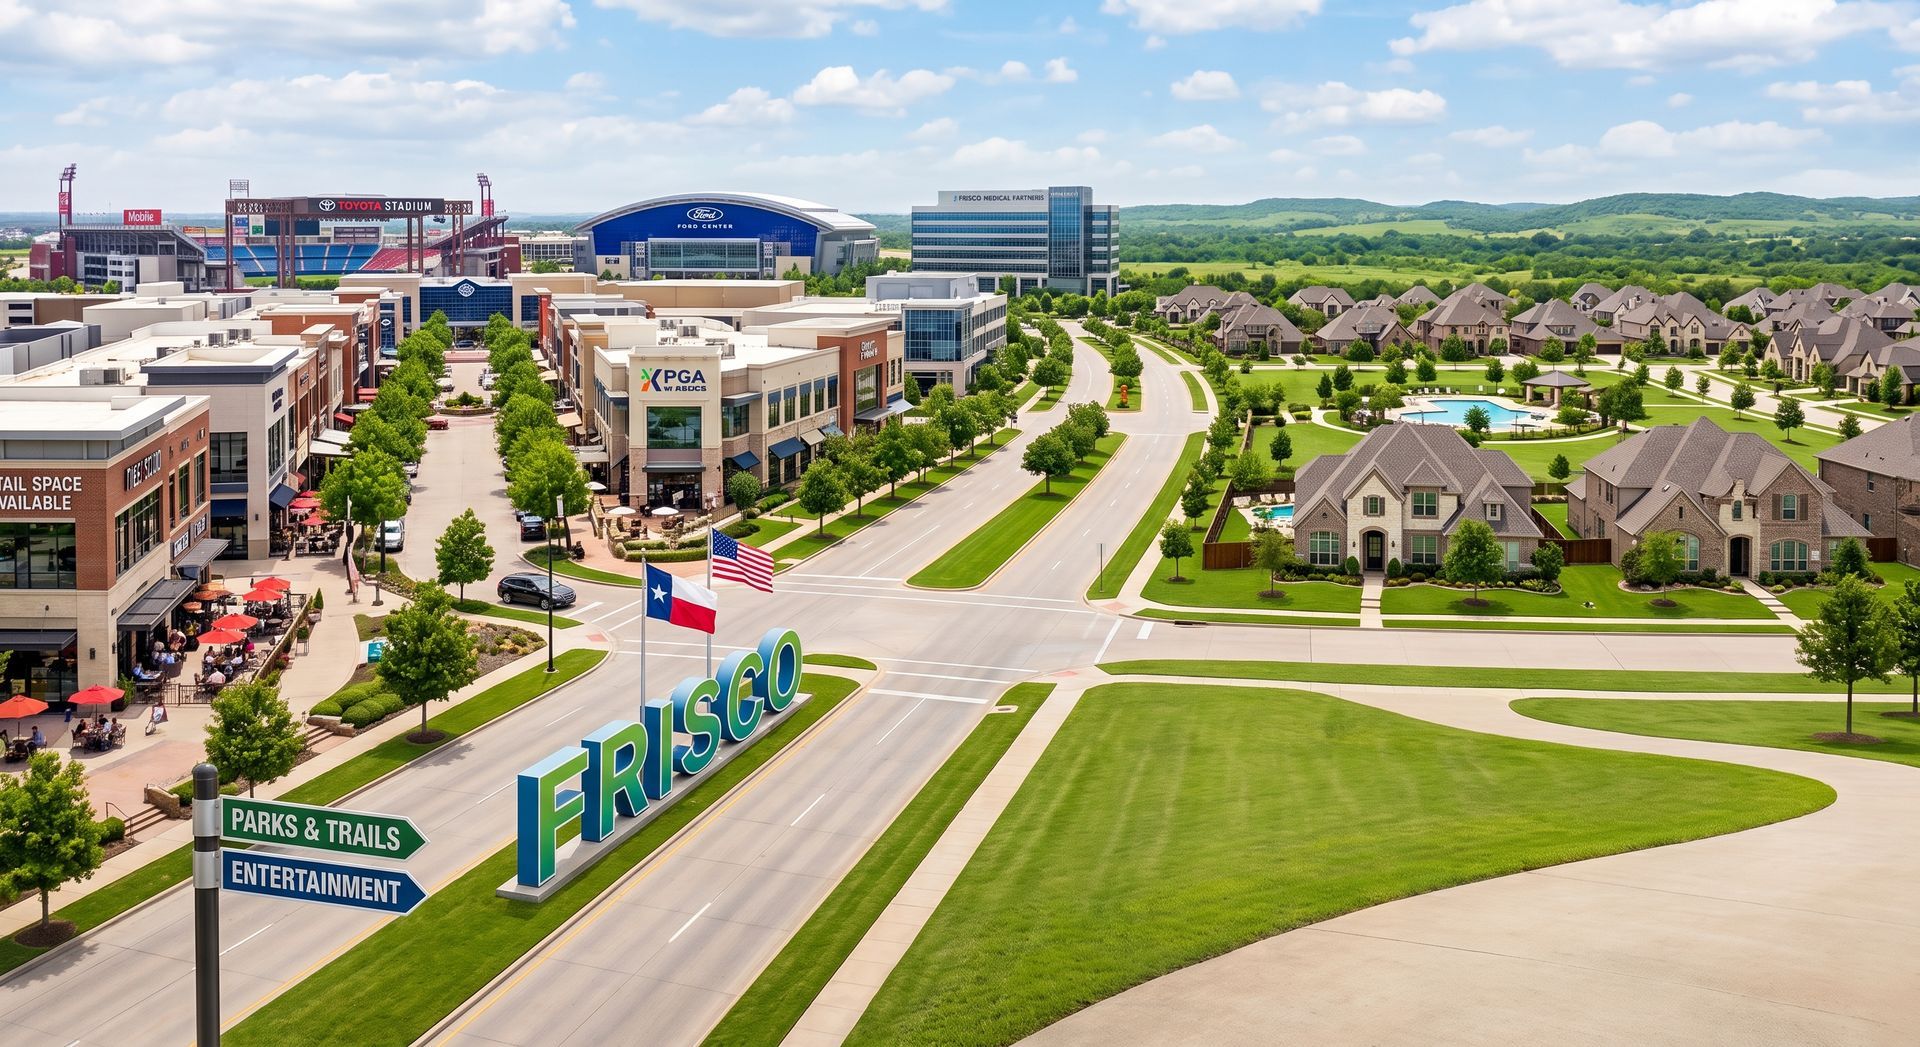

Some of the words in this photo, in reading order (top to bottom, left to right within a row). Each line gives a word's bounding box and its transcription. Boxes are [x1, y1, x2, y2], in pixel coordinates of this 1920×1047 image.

[338, 201, 382, 211] TOYOTA
[385, 201, 432, 211] STADIUM
[32, 476, 82, 492] SPACE
[517, 627, 803, 888] FRISCO
[231, 807, 298, 839] PARKS
[304, 816, 320, 841] &
[325, 819, 401, 851] TRAILS
[231, 860, 402, 905] ENTERTAINMENT
